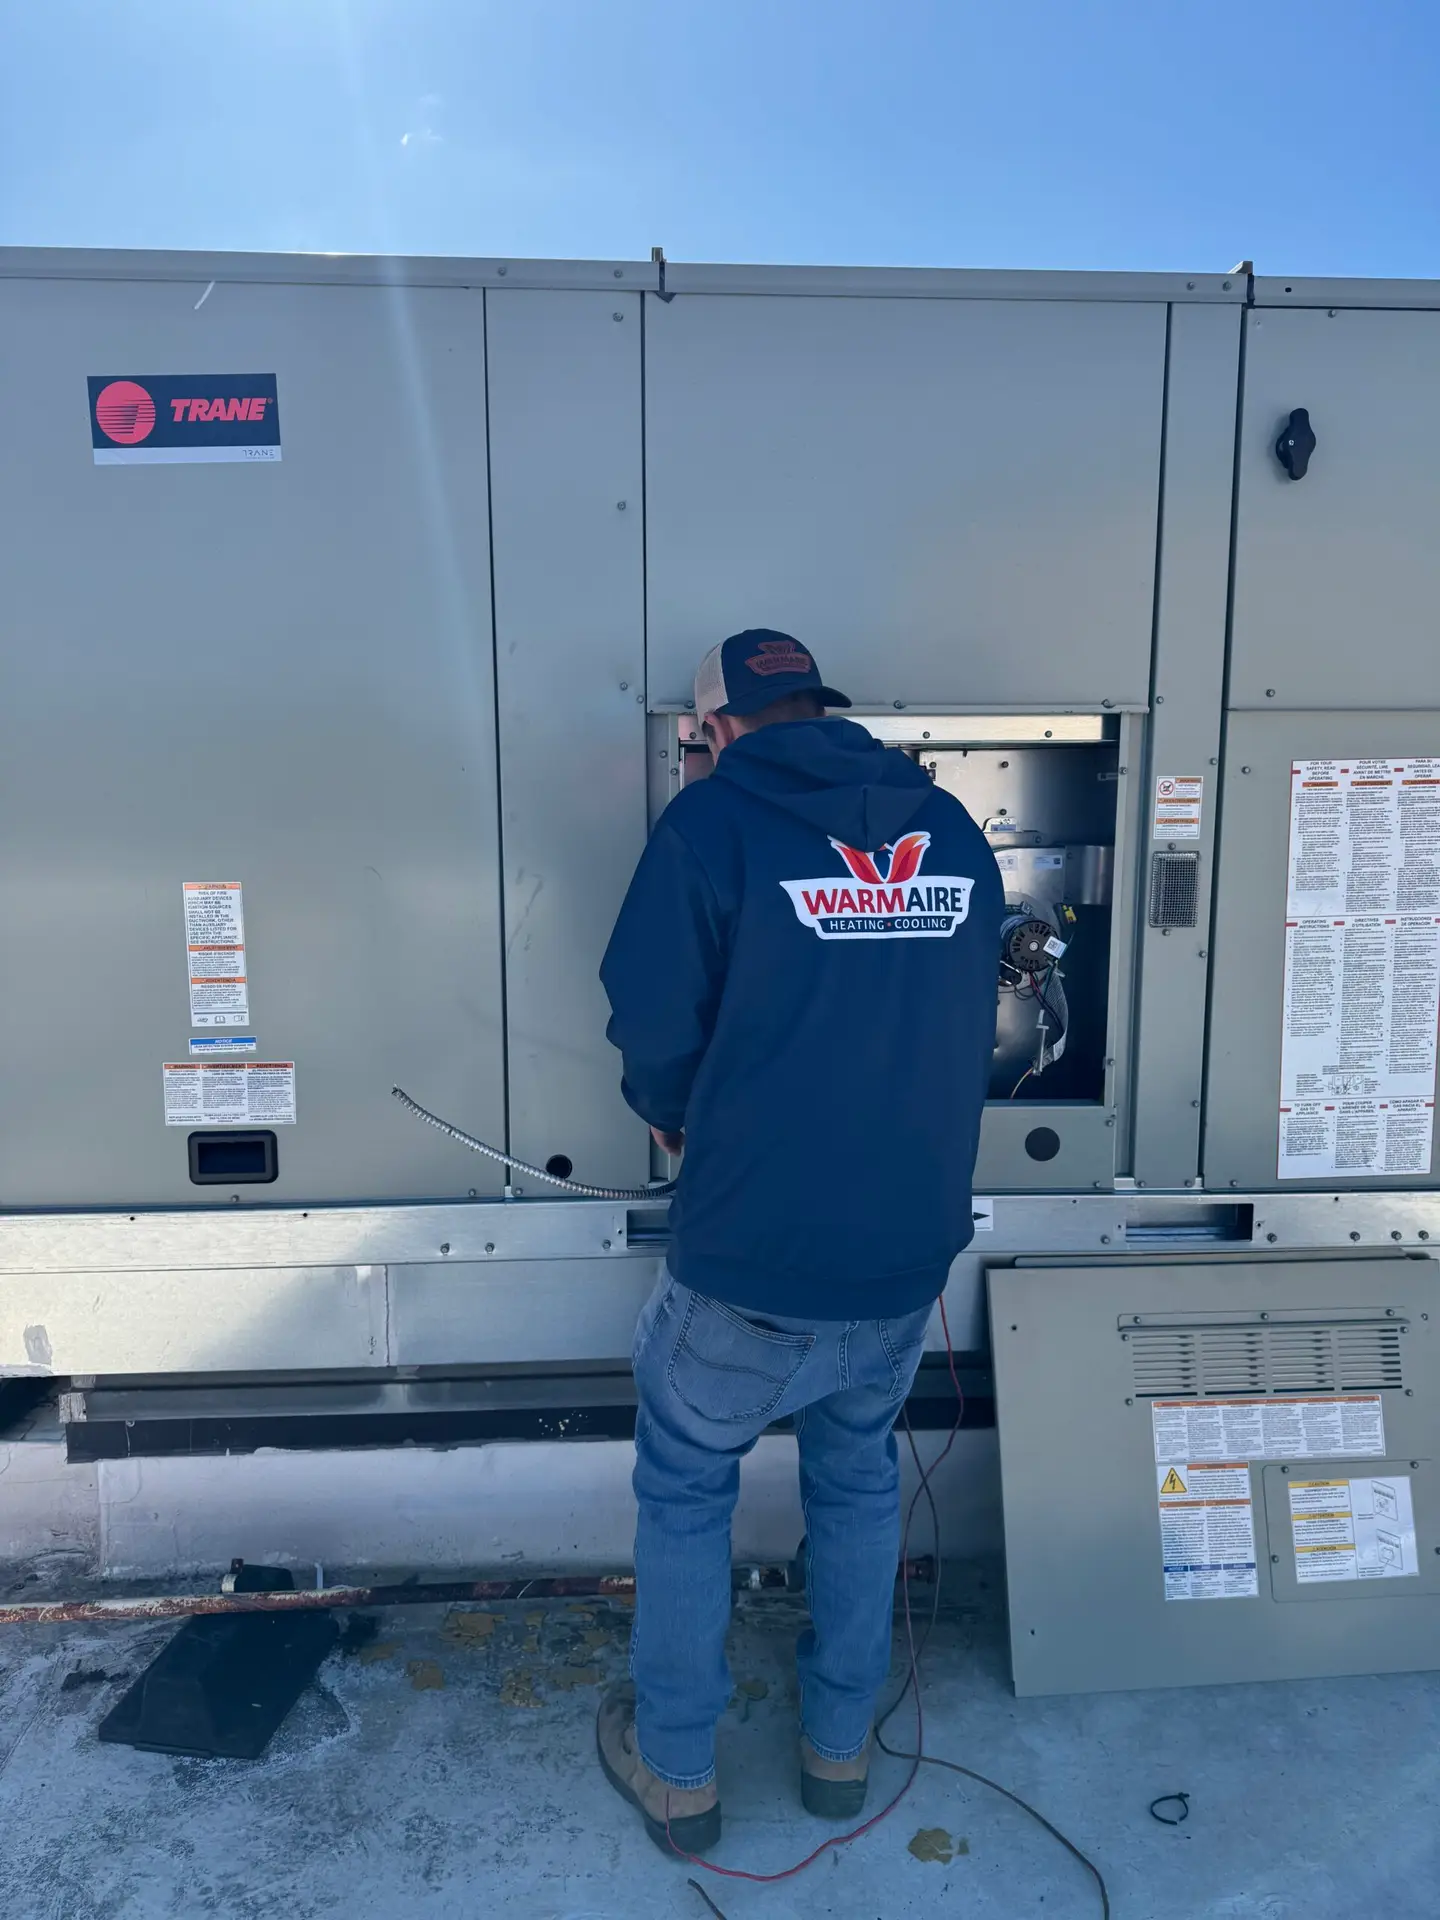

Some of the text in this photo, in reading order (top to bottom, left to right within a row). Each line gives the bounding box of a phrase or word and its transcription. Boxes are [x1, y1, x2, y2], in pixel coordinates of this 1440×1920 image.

[171, 398, 267, 422] TRANE
[243, 449, 274, 457] TRANE
[801, 887, 963, 915] WARMAIRE
[830, 918, 947, 930] HEATING COOLING
